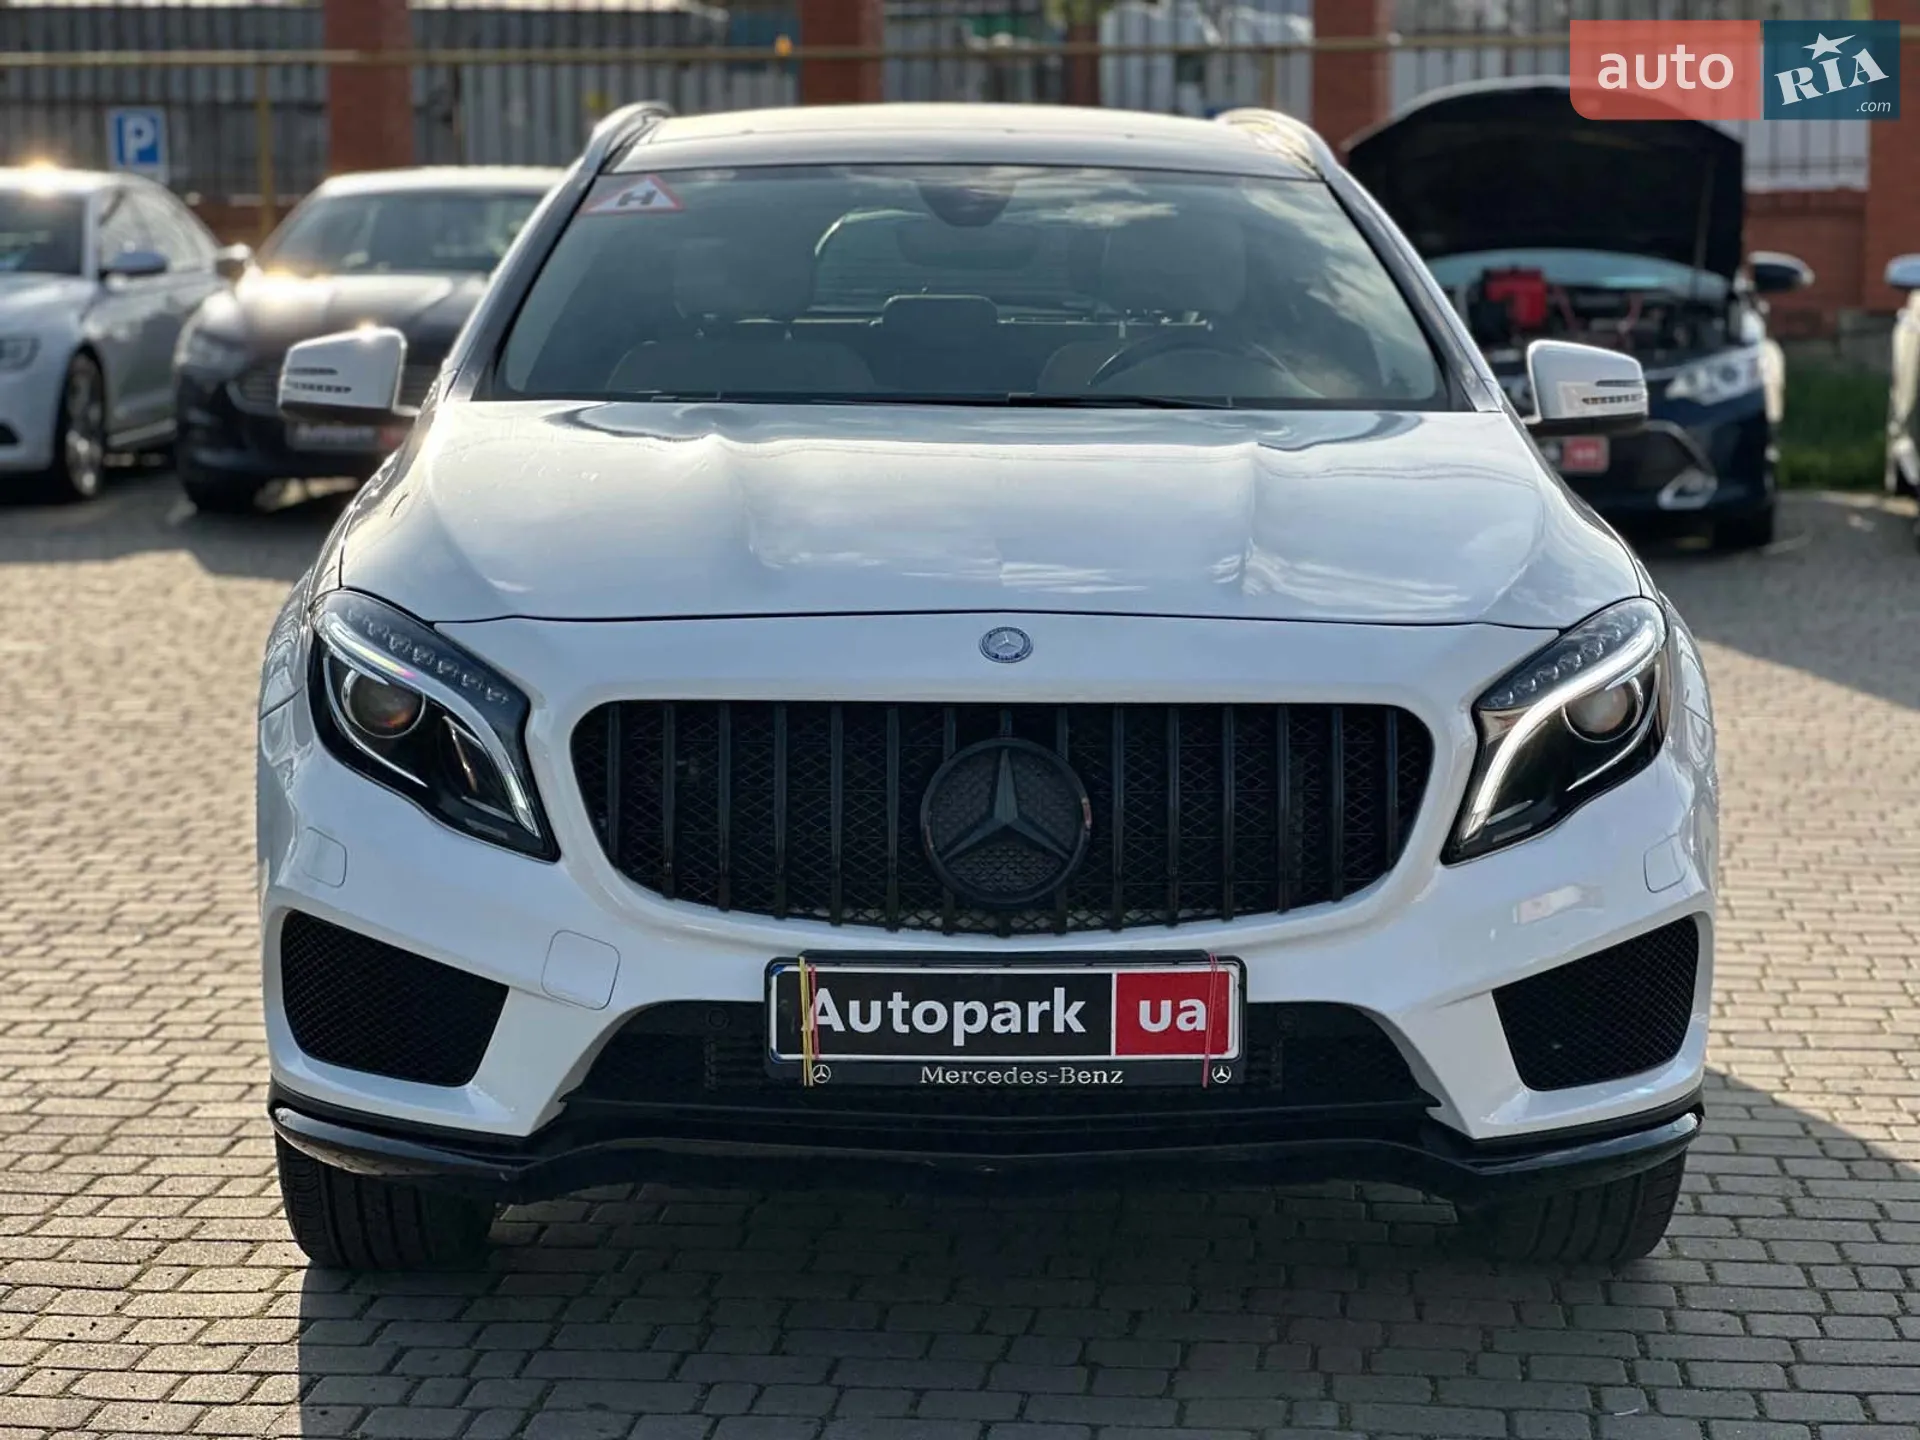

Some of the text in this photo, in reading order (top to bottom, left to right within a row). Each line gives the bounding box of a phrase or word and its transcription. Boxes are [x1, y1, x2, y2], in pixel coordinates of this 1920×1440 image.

[125, 117, 155, 160] P
[801, 987, 1207, 1047] Autopark ua
[919, 1065, 1125, 1086] Mercedes-Benz
